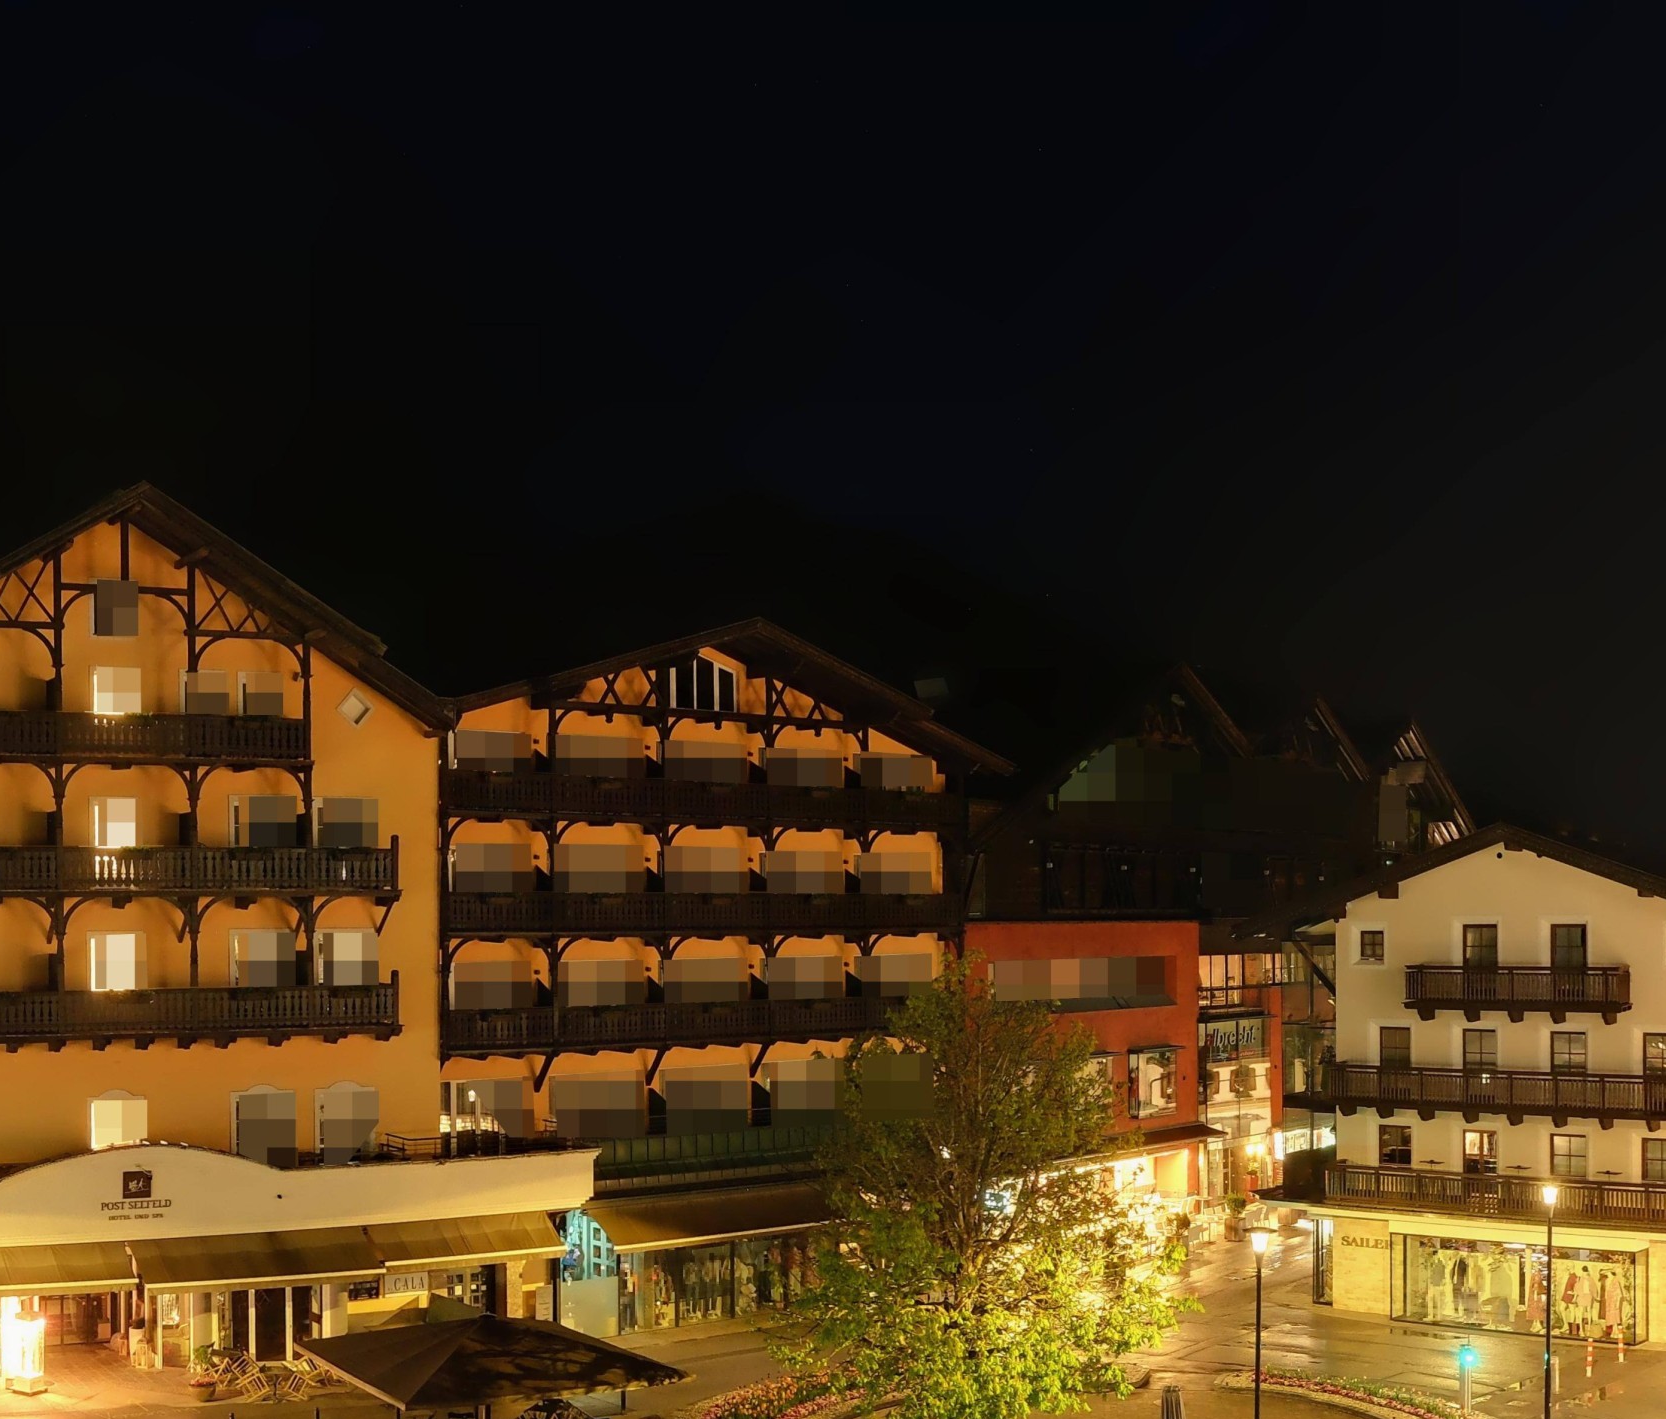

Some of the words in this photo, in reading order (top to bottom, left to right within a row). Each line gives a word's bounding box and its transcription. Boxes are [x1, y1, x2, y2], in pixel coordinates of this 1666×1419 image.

[101, 1201, 127, 1211] POST
[128, 1199, 172, 1210] SEEFELD
[393, 1276, 425, 1291] CALA
